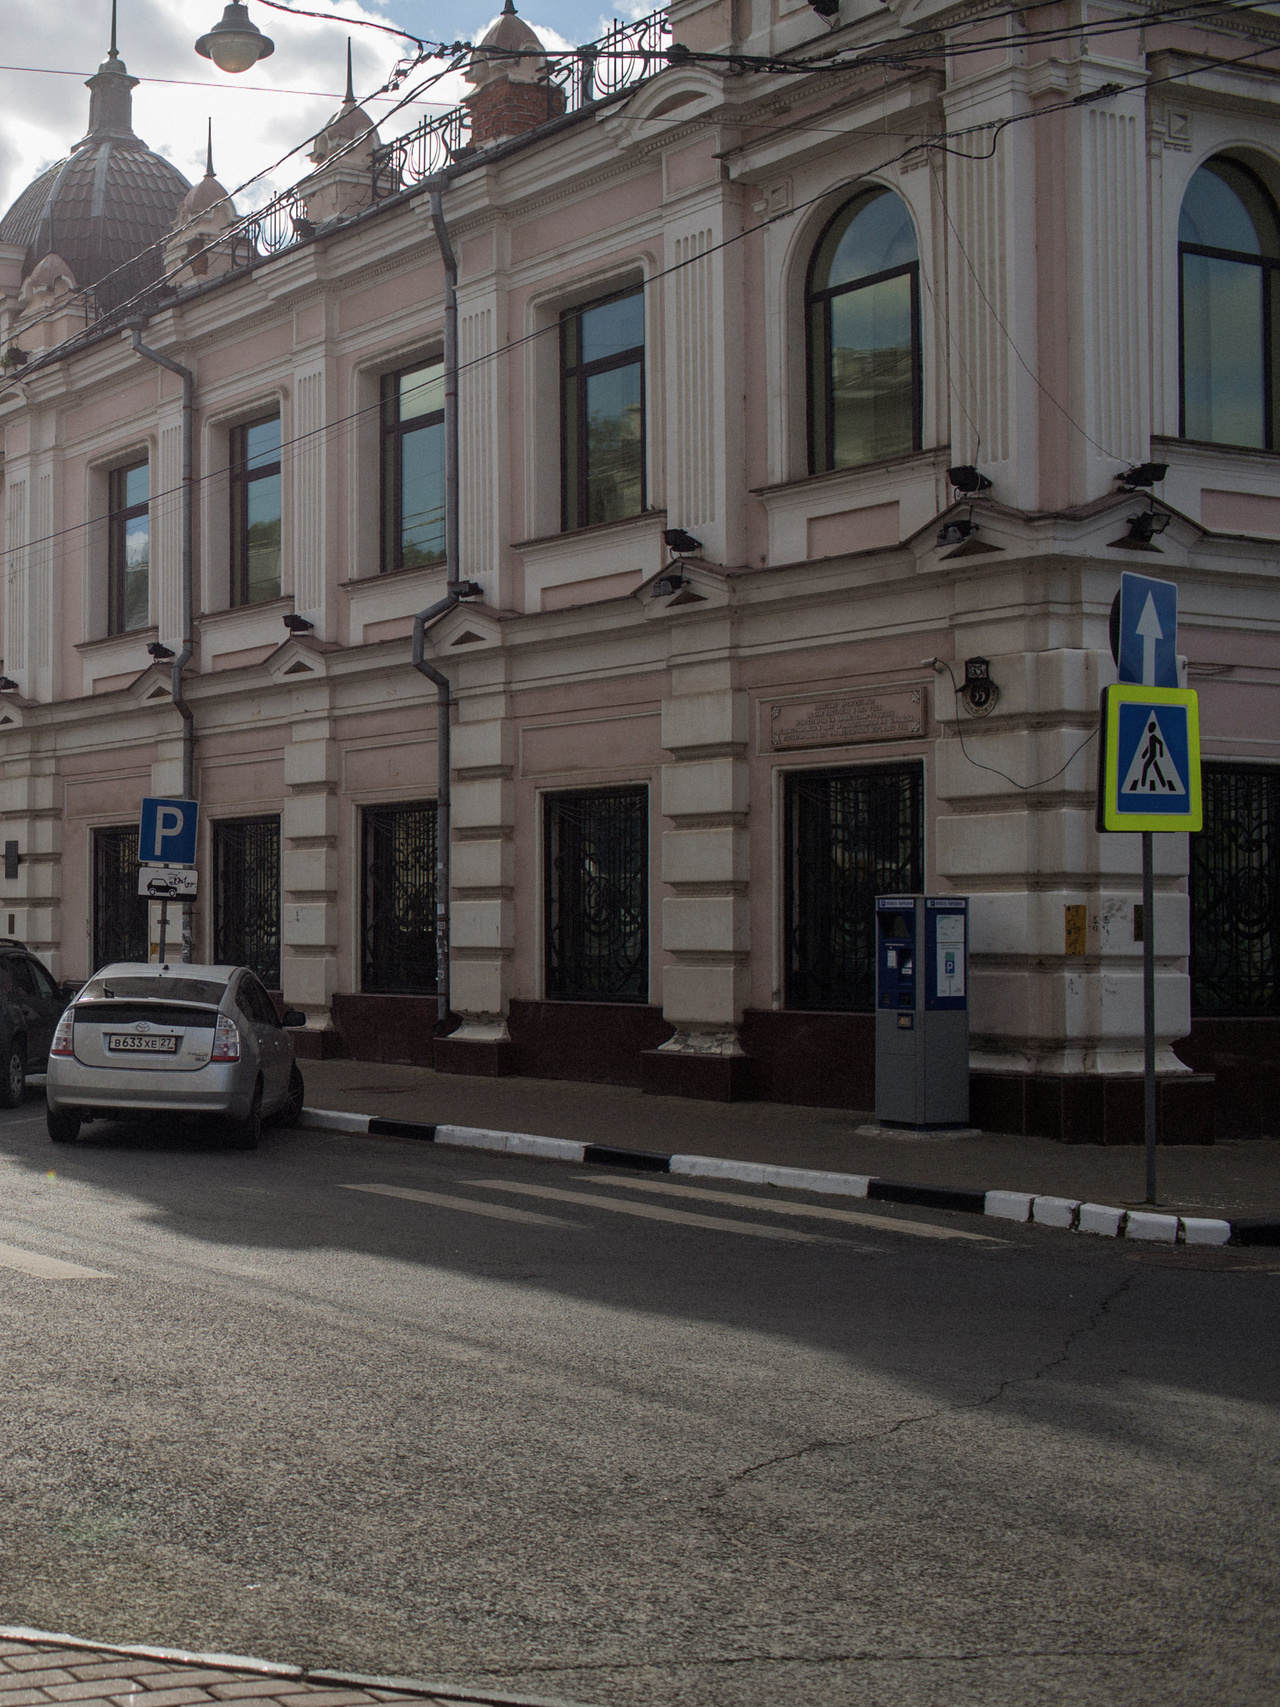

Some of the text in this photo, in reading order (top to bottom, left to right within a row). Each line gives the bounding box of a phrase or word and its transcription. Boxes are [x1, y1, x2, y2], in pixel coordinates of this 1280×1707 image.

[154, 805, 184, 856] P
[114, 1037, 172, 1048] В633ХЕ 27
